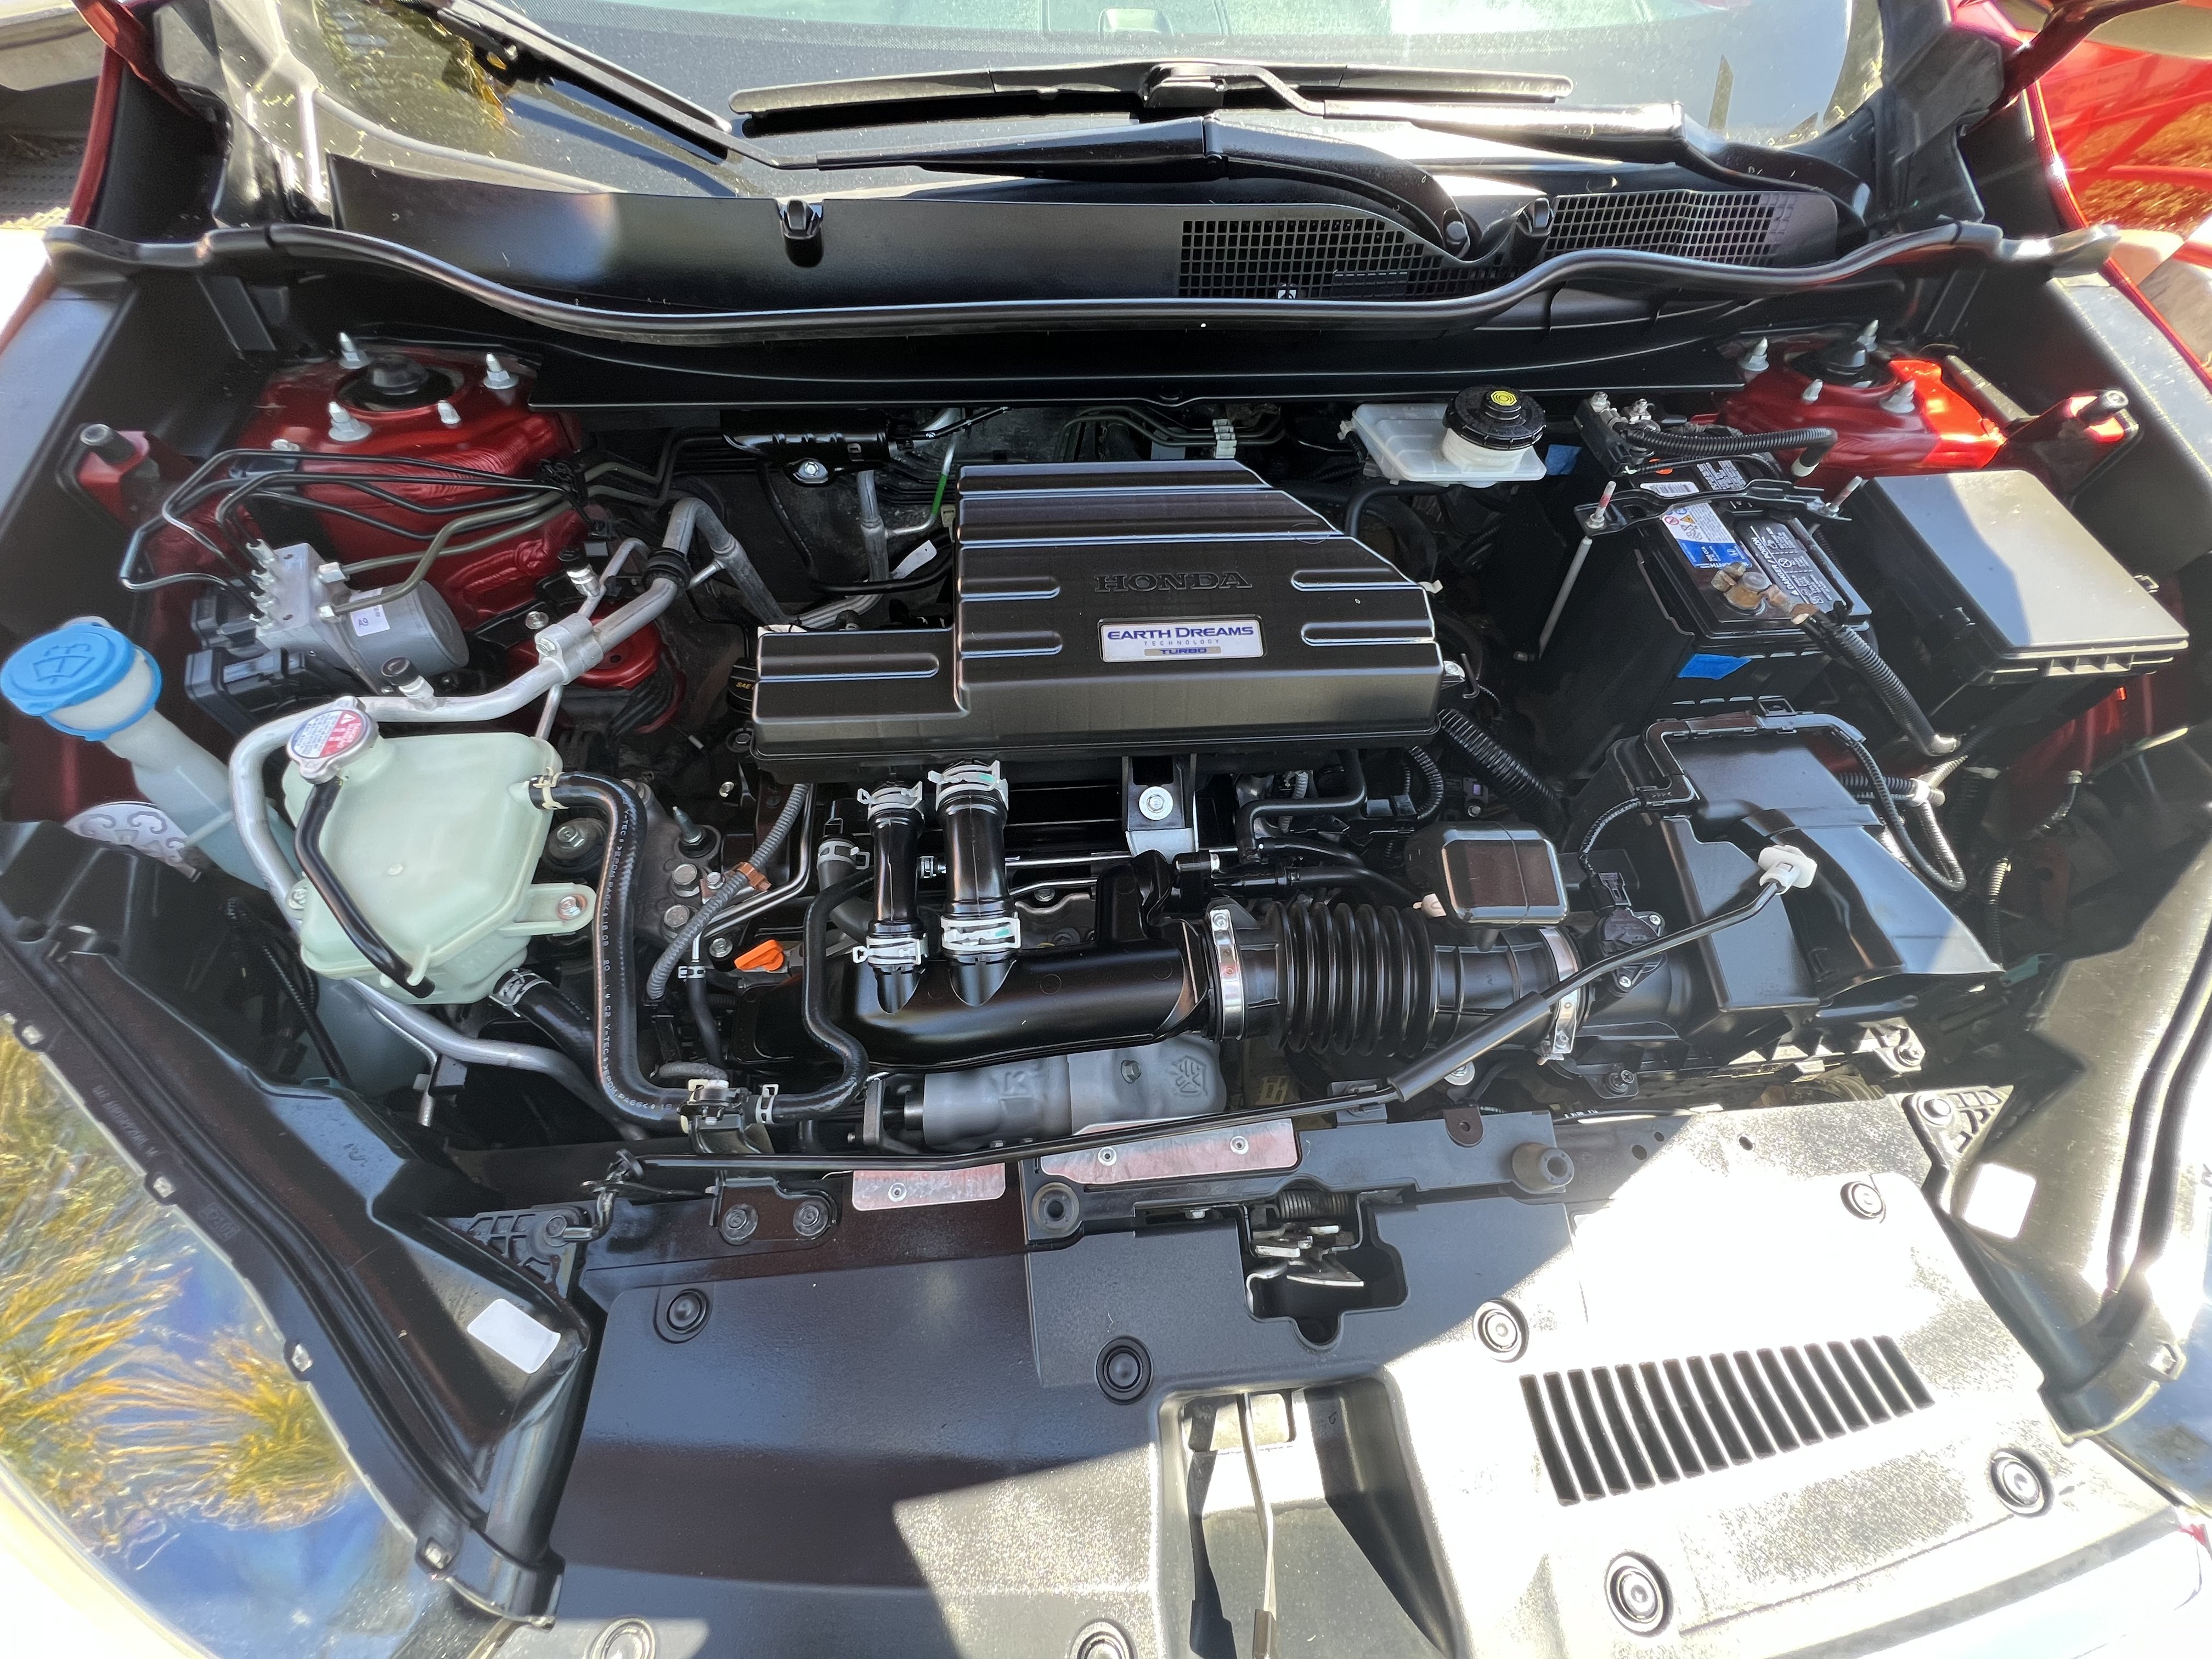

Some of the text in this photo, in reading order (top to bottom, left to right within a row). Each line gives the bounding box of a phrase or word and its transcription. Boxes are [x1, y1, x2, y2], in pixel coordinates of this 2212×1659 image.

[1751, 537, 1772, 558] POISON
[1095, 572, 1253, 592] HONDA
[1771, 564, 1794, 589] DANGER
[358, 617, 369, 628] A9
[1107, 627, 1254, 640] EARTH DREAMS
[619, 809, 629, 836] Y-TEC
